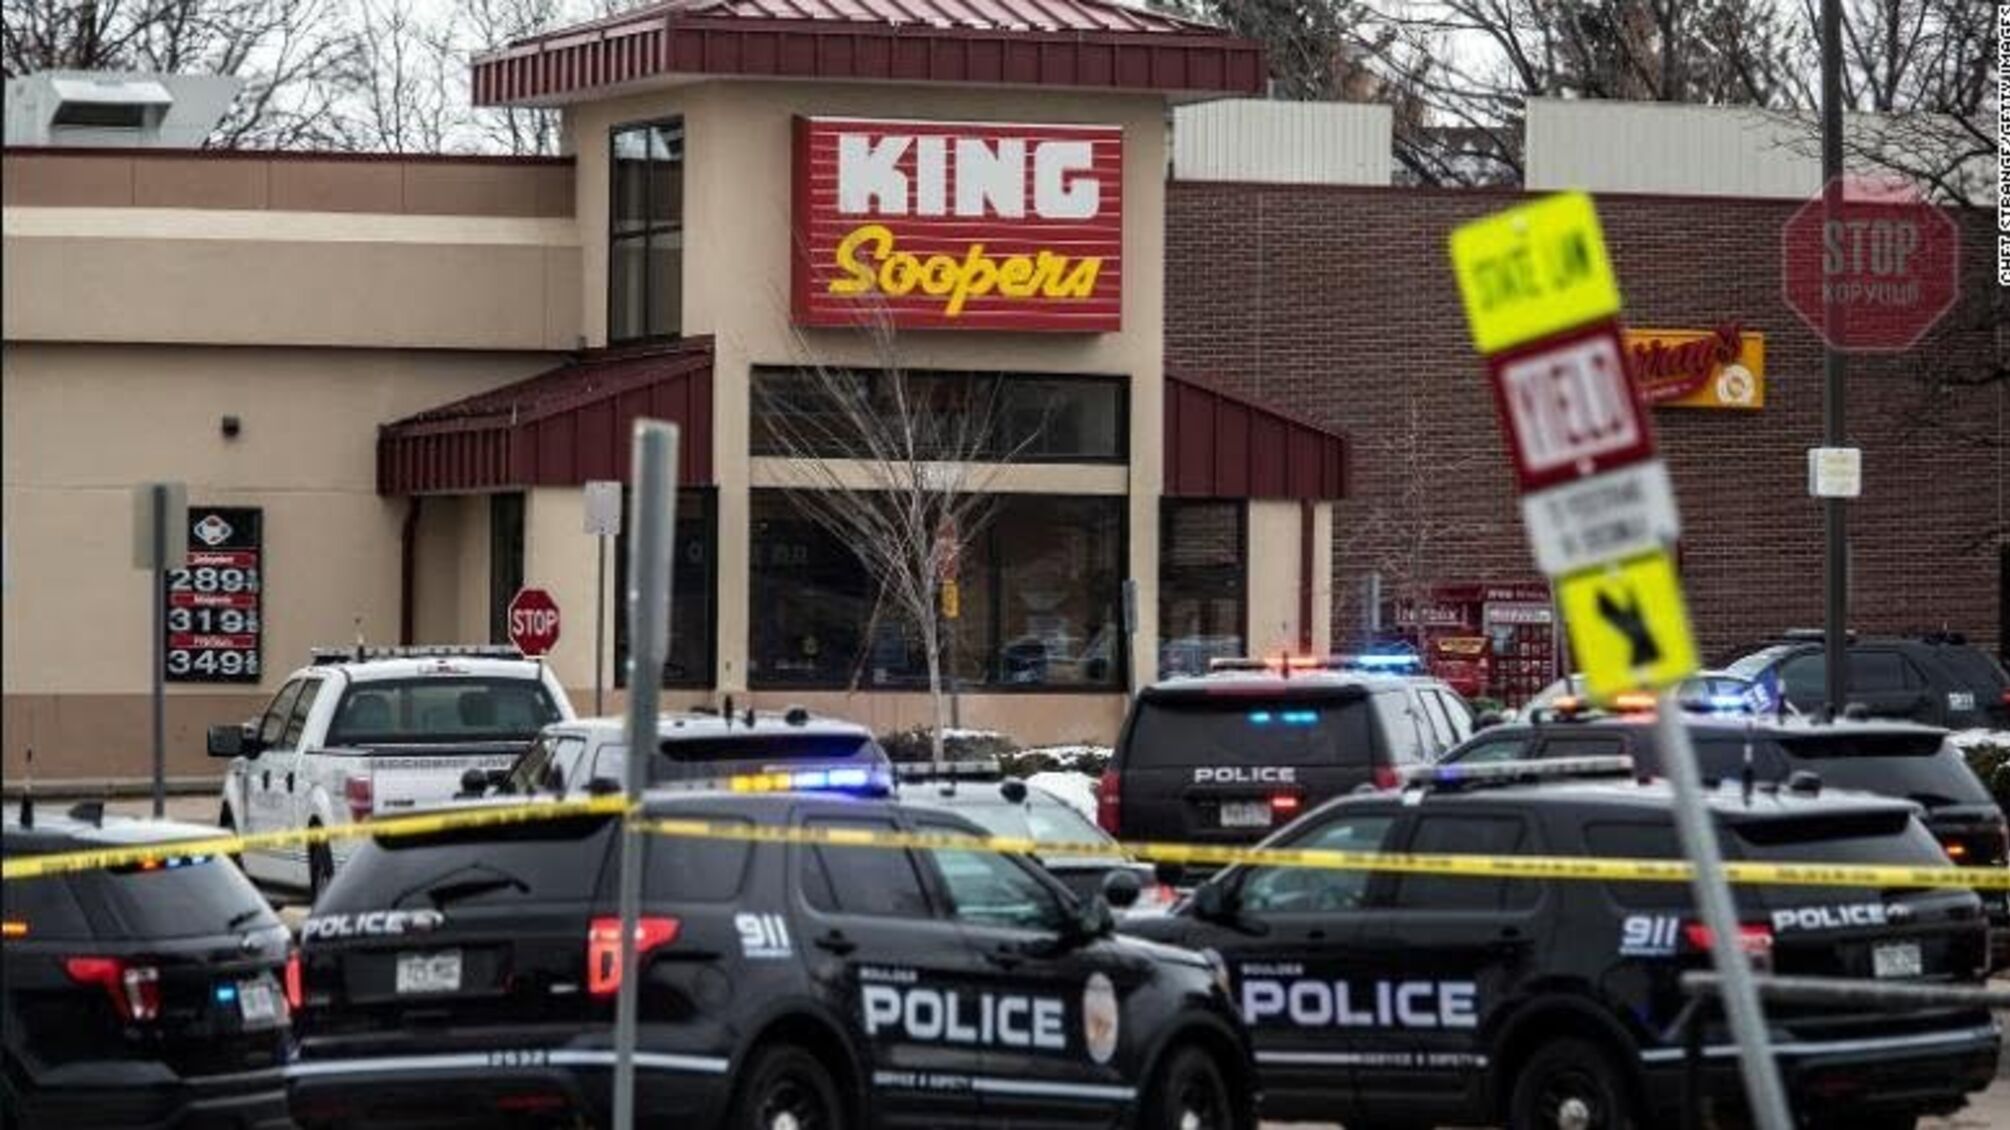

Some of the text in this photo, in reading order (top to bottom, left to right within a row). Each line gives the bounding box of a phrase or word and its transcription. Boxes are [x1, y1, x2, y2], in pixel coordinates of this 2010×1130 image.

[838, 132, 1100, 219] KING
[829, 223, 1102, 317] Soopers
[169, 567, 244, 592] 289
[168, 608, 244, 633] 319
[512, 609, 558, 636] STOP
[168, 650, 244, 675] 349
[1194, 767, 1297, 782] POLICE
[302, 910, 406, 944] POLICE
[735, 913, 789, 947] 911
[1623, 917, 1677, 946] 911
[1772, 905, 1887, 931] POLICE
[862, 984, 1067, 1048] POLICE
[1242, 980, 1478, 1027] POLICE
